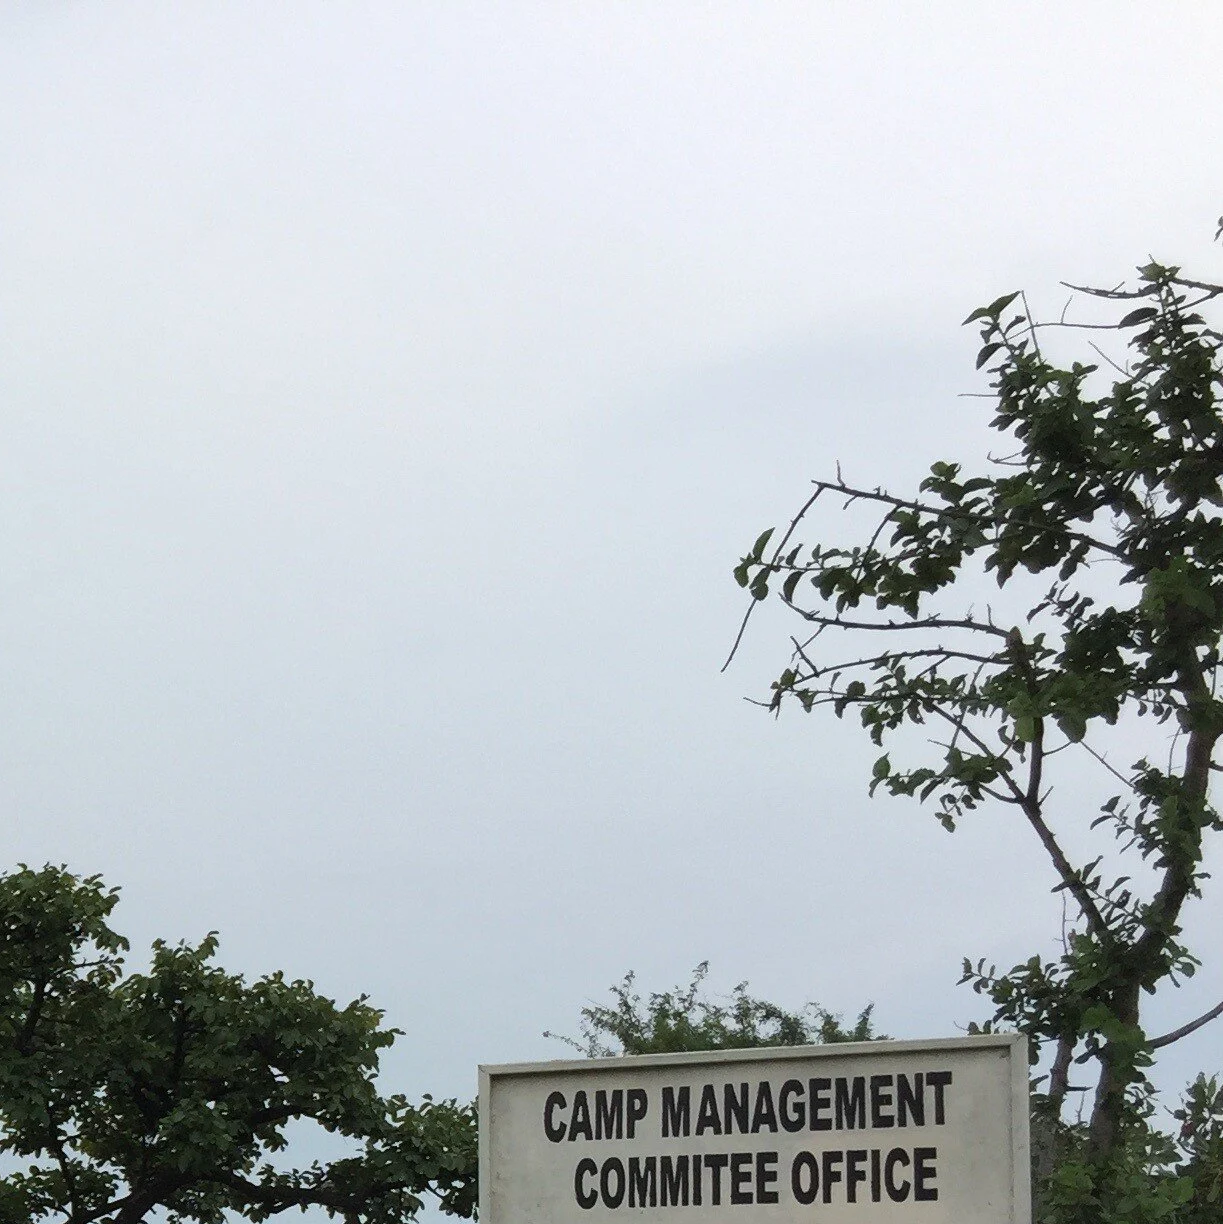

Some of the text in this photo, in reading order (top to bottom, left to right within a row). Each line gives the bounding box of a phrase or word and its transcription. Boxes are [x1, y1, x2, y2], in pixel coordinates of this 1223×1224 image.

[544, 1071, 953, 1143] CAMP MANAGEMENT
[574, 1147, 939, 1209] COMMITEE OFFICE
